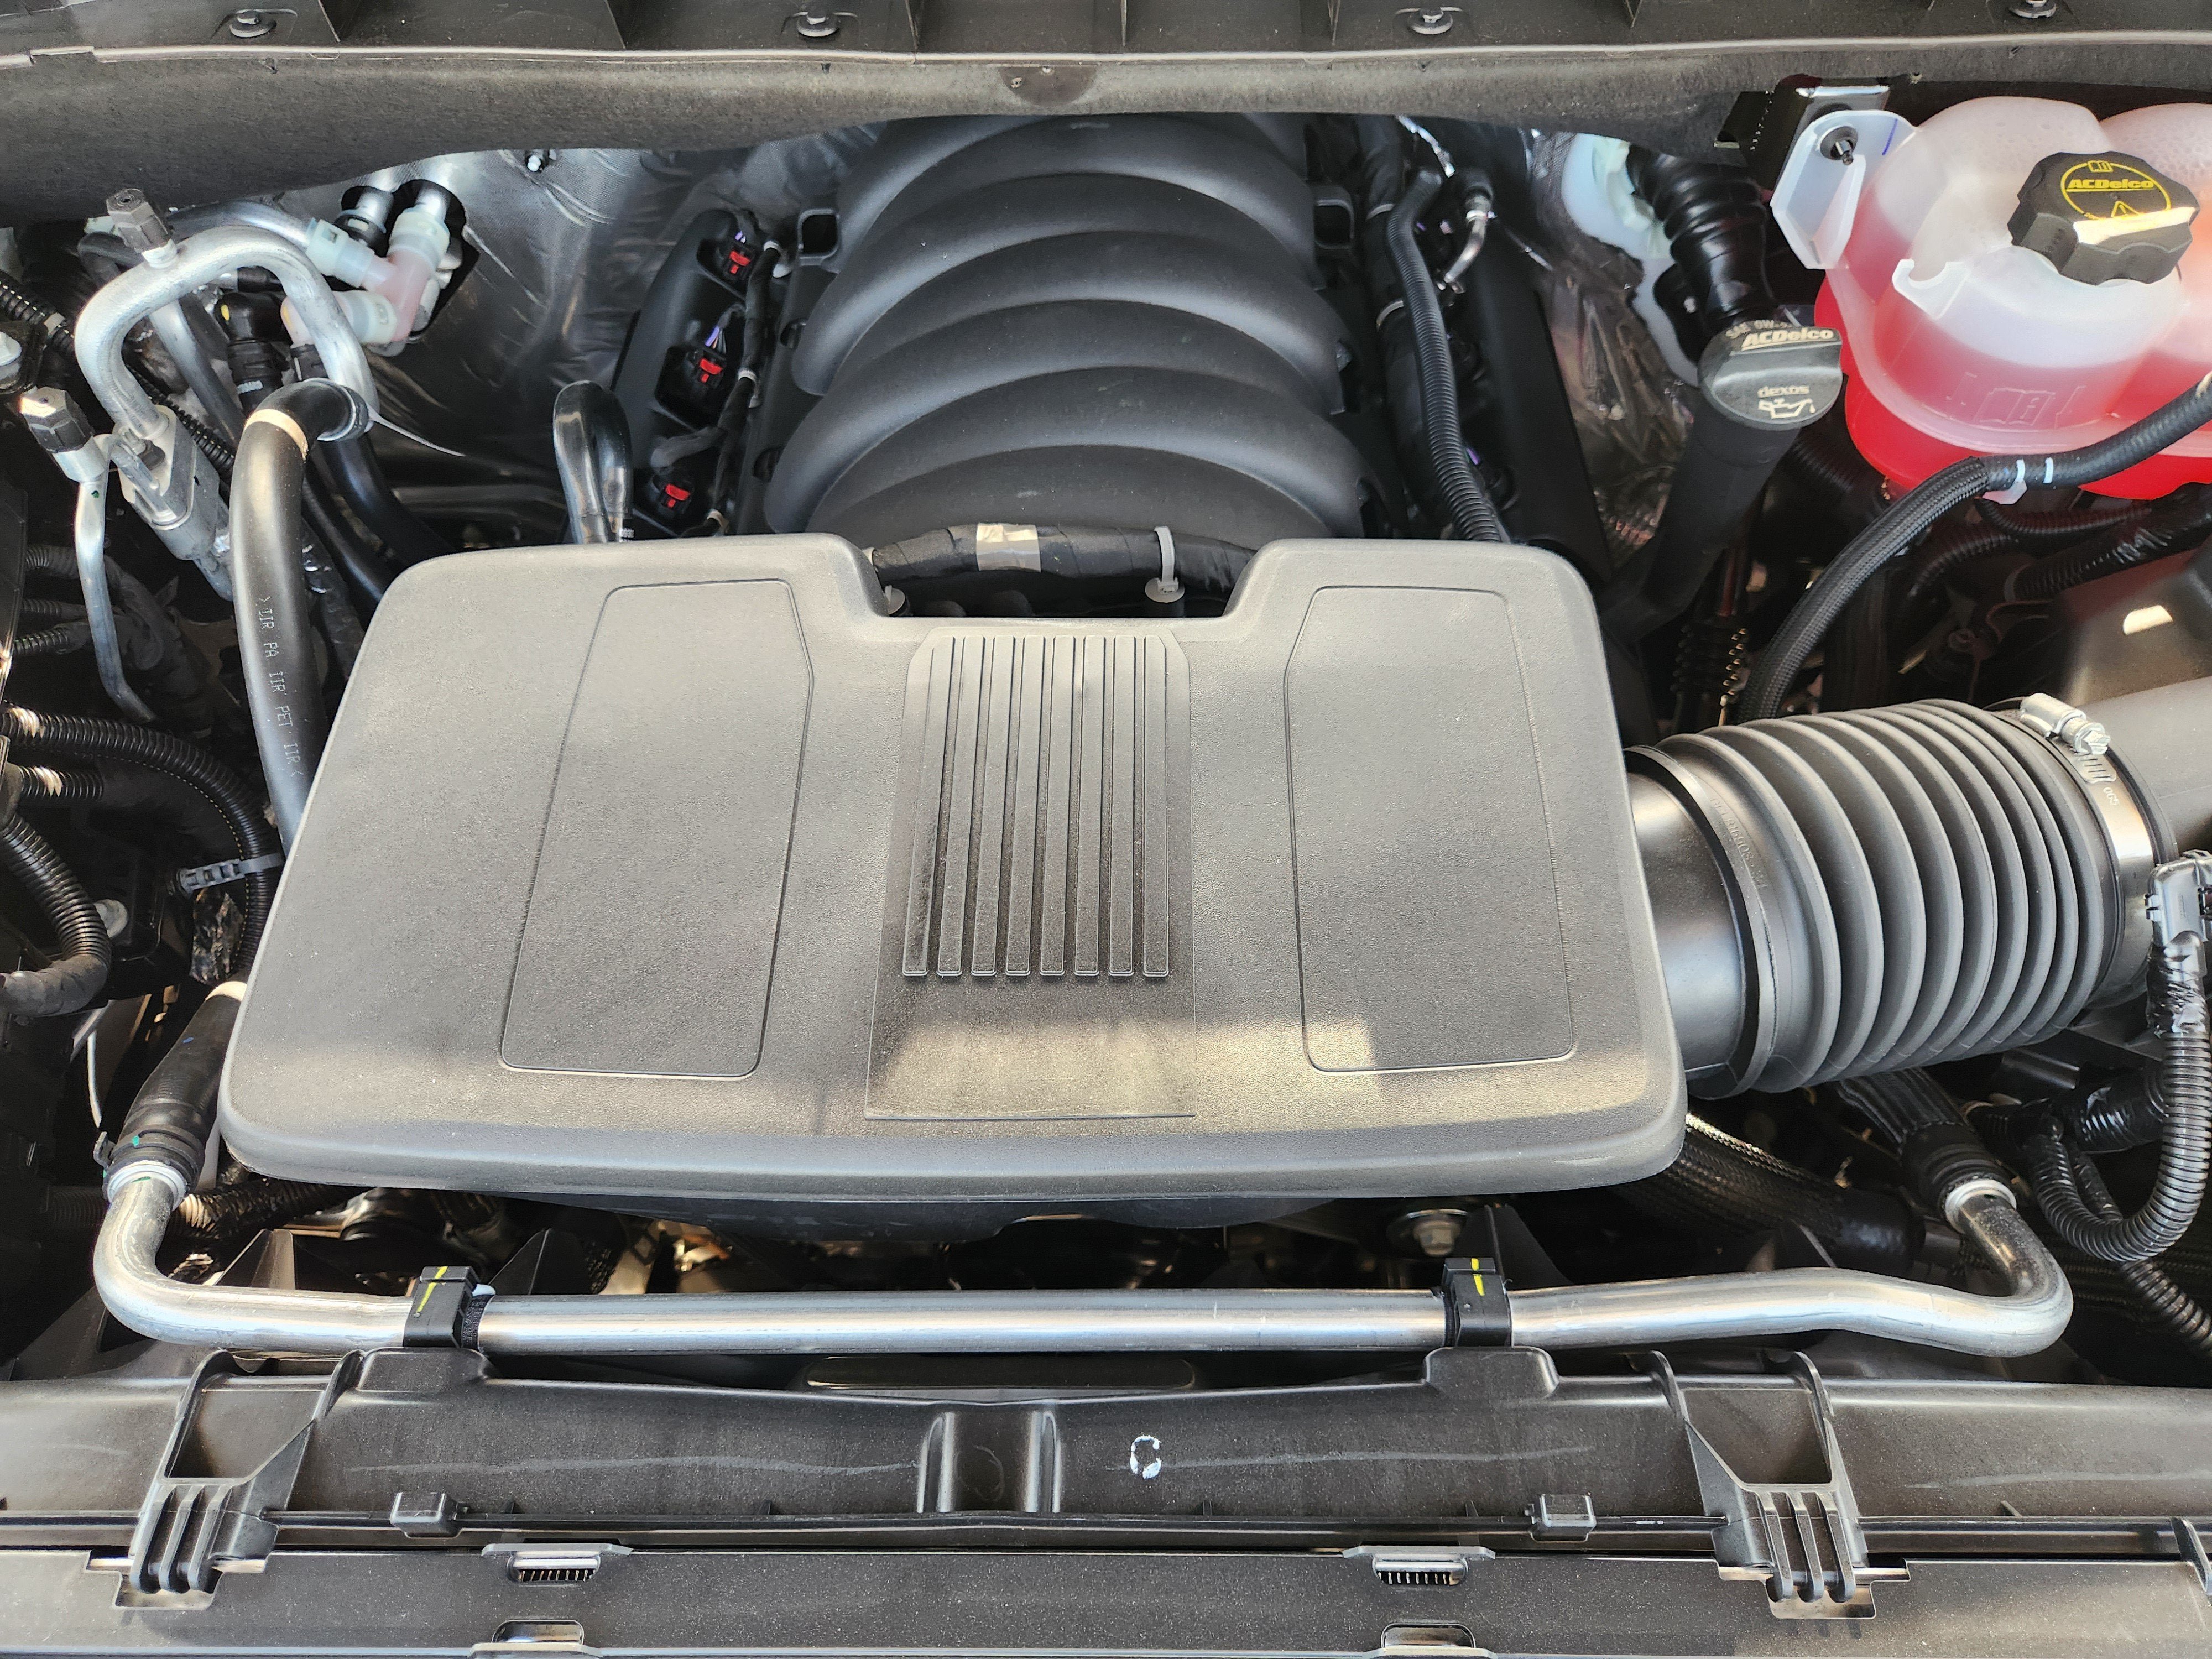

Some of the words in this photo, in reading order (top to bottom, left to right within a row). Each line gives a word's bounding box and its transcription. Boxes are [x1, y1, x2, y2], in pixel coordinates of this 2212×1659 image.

[2067, 179, 2154, 189] ACDelco
[1725, 322, 1752, 339] SAE
[1741, 328, 1834, 348] ACDelco
[1757, 385, 1810, 398] dexos
[263, 641, 279, 658] PA
[275, 705, 293, 727] PET
